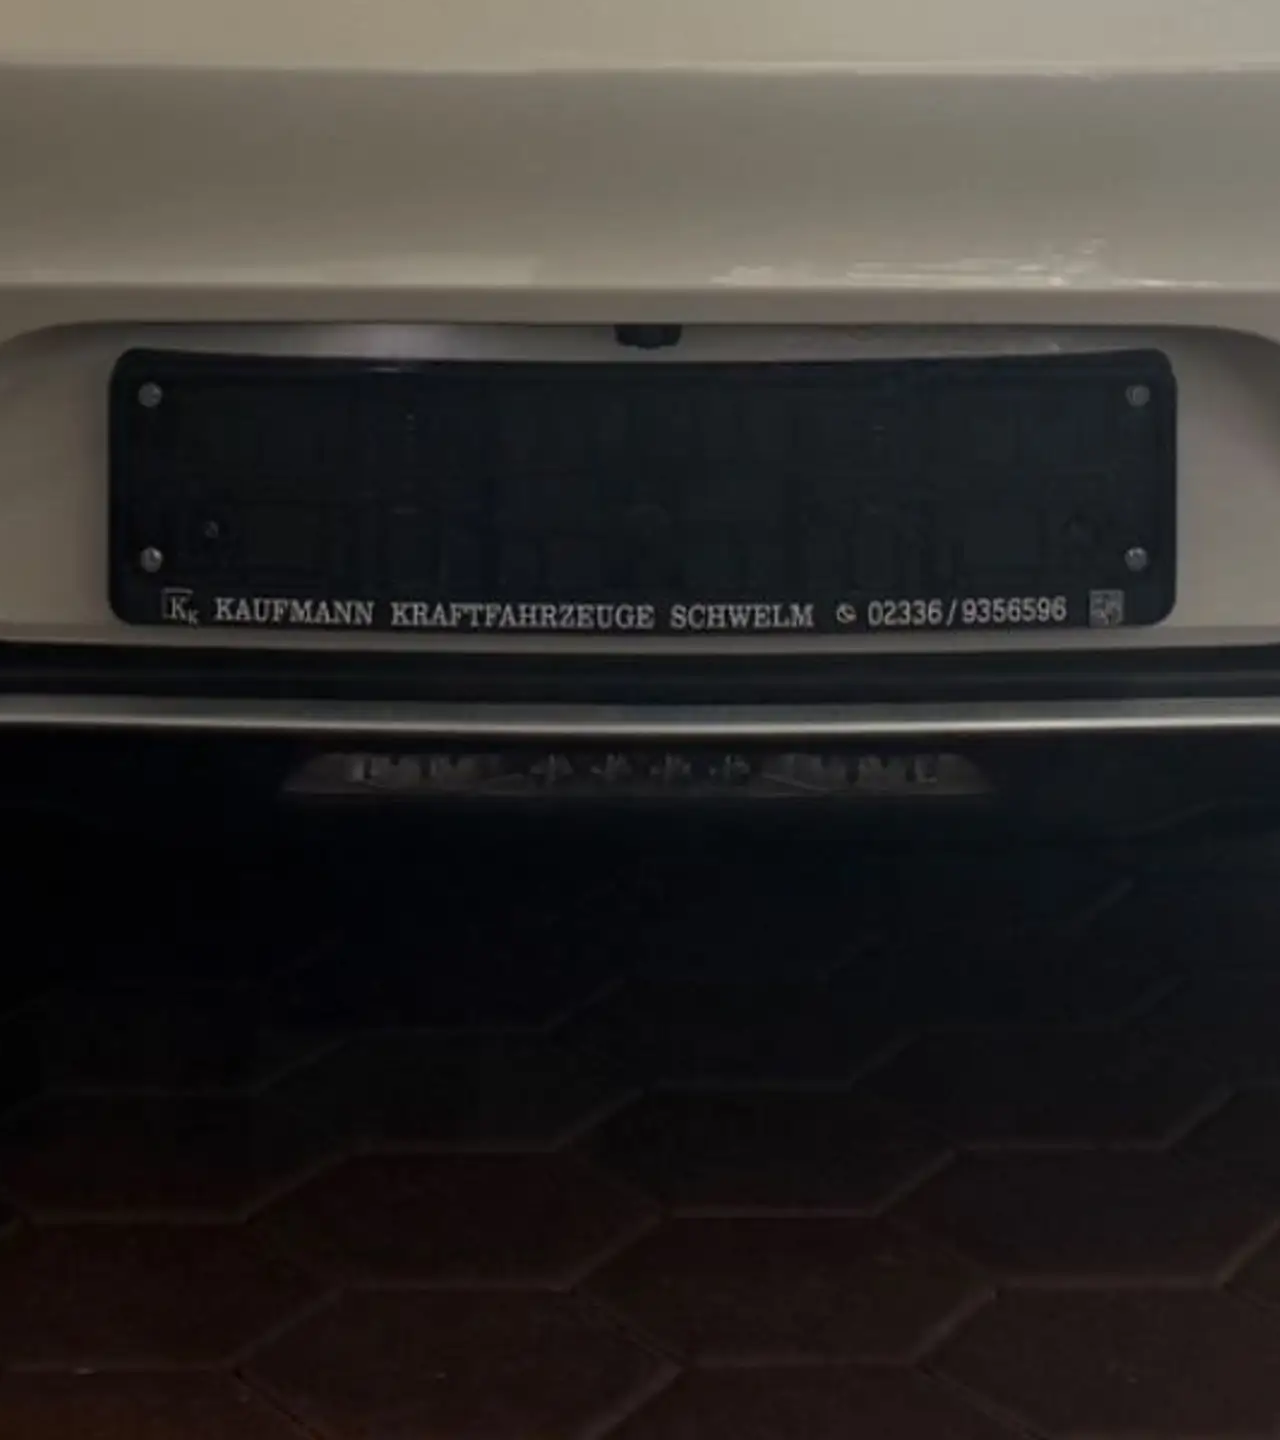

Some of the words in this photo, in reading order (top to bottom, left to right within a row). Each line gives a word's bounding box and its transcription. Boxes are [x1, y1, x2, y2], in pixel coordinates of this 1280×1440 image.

[214, 597, 375, 626] KAUFMANN
[391, 601, 656, 629] KRAFTFAHRZEUGE
[669, 603, 815, 630] SCHWELM
